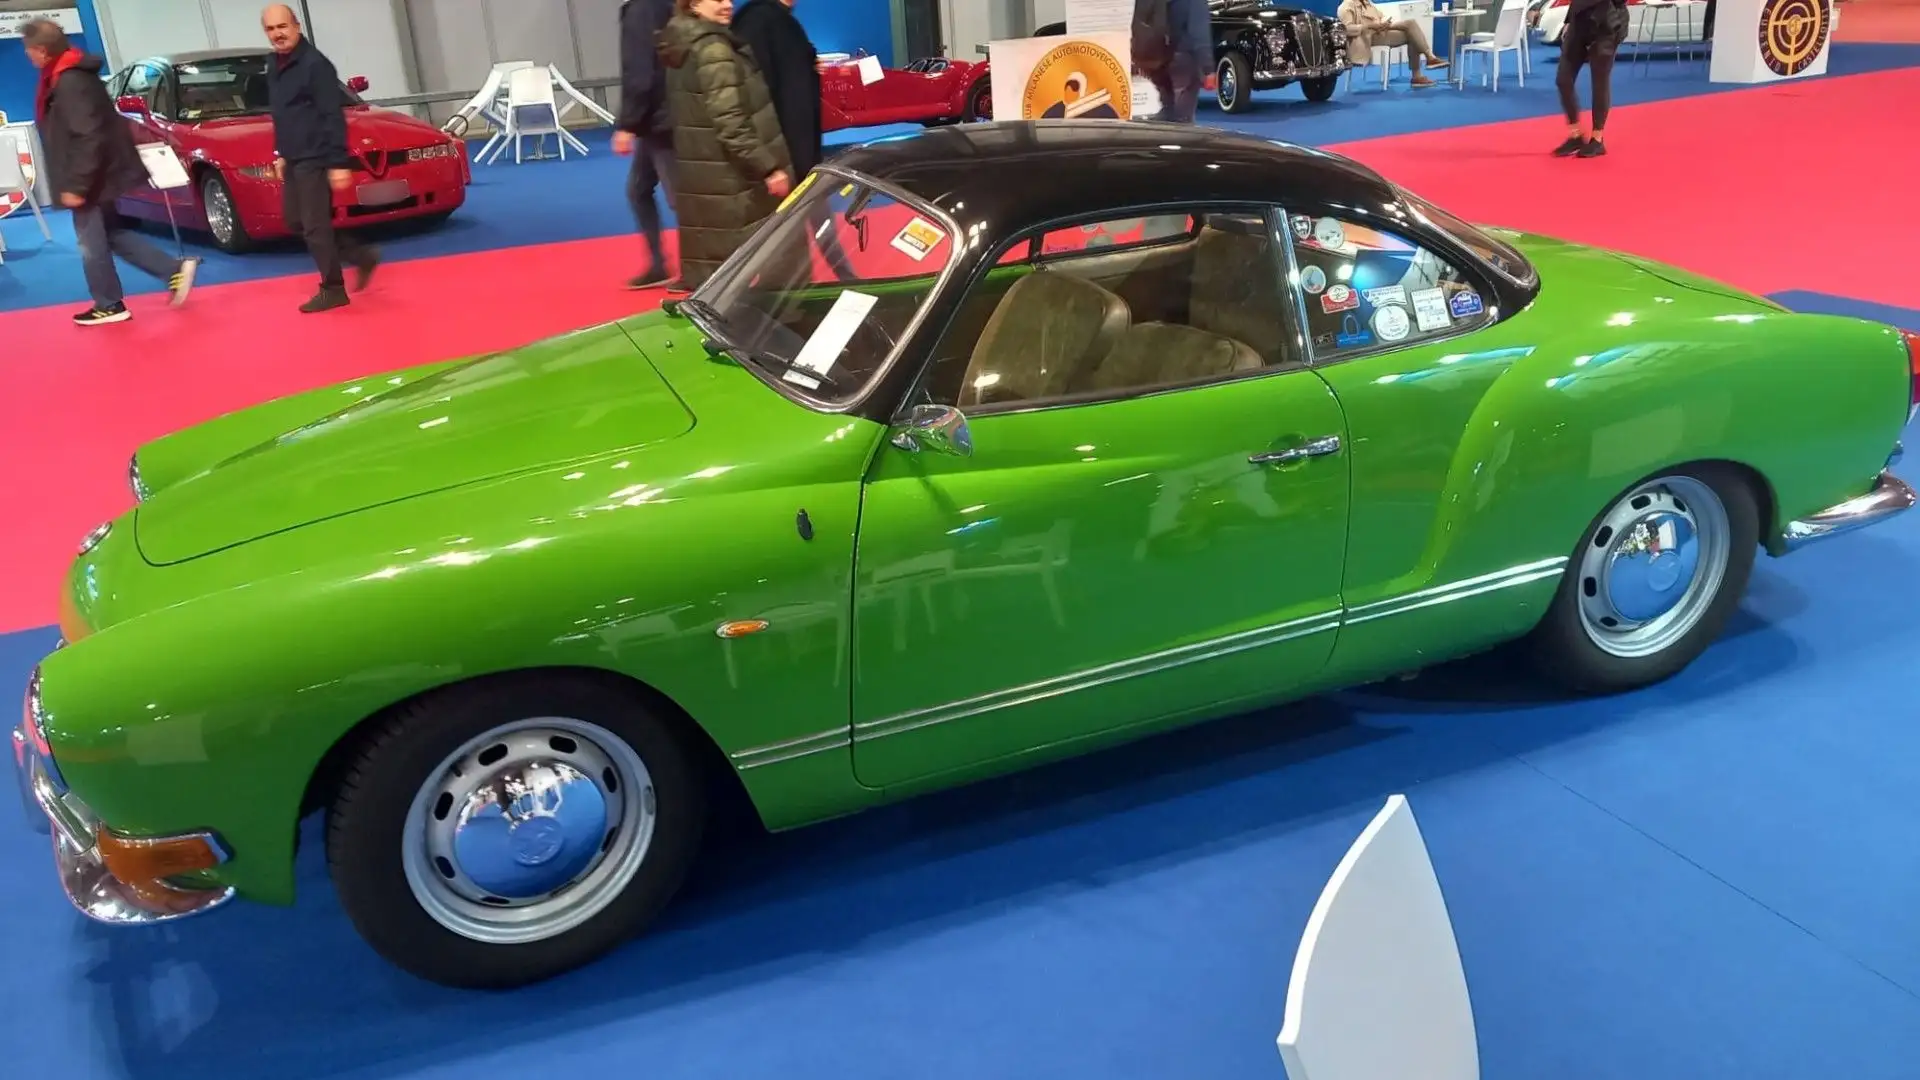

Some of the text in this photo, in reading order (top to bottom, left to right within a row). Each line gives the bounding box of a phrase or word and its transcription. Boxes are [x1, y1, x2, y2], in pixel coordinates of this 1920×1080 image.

[1760, 7, 1829, 71] EUGENIO CASTELLOTTI
[1027, 59, 1052, 100] MILANESE
[1052, 46, 1120, 75] AUTOMOTOVEICOLI
[1117, 76, 1129, 116] D'EPOCA
